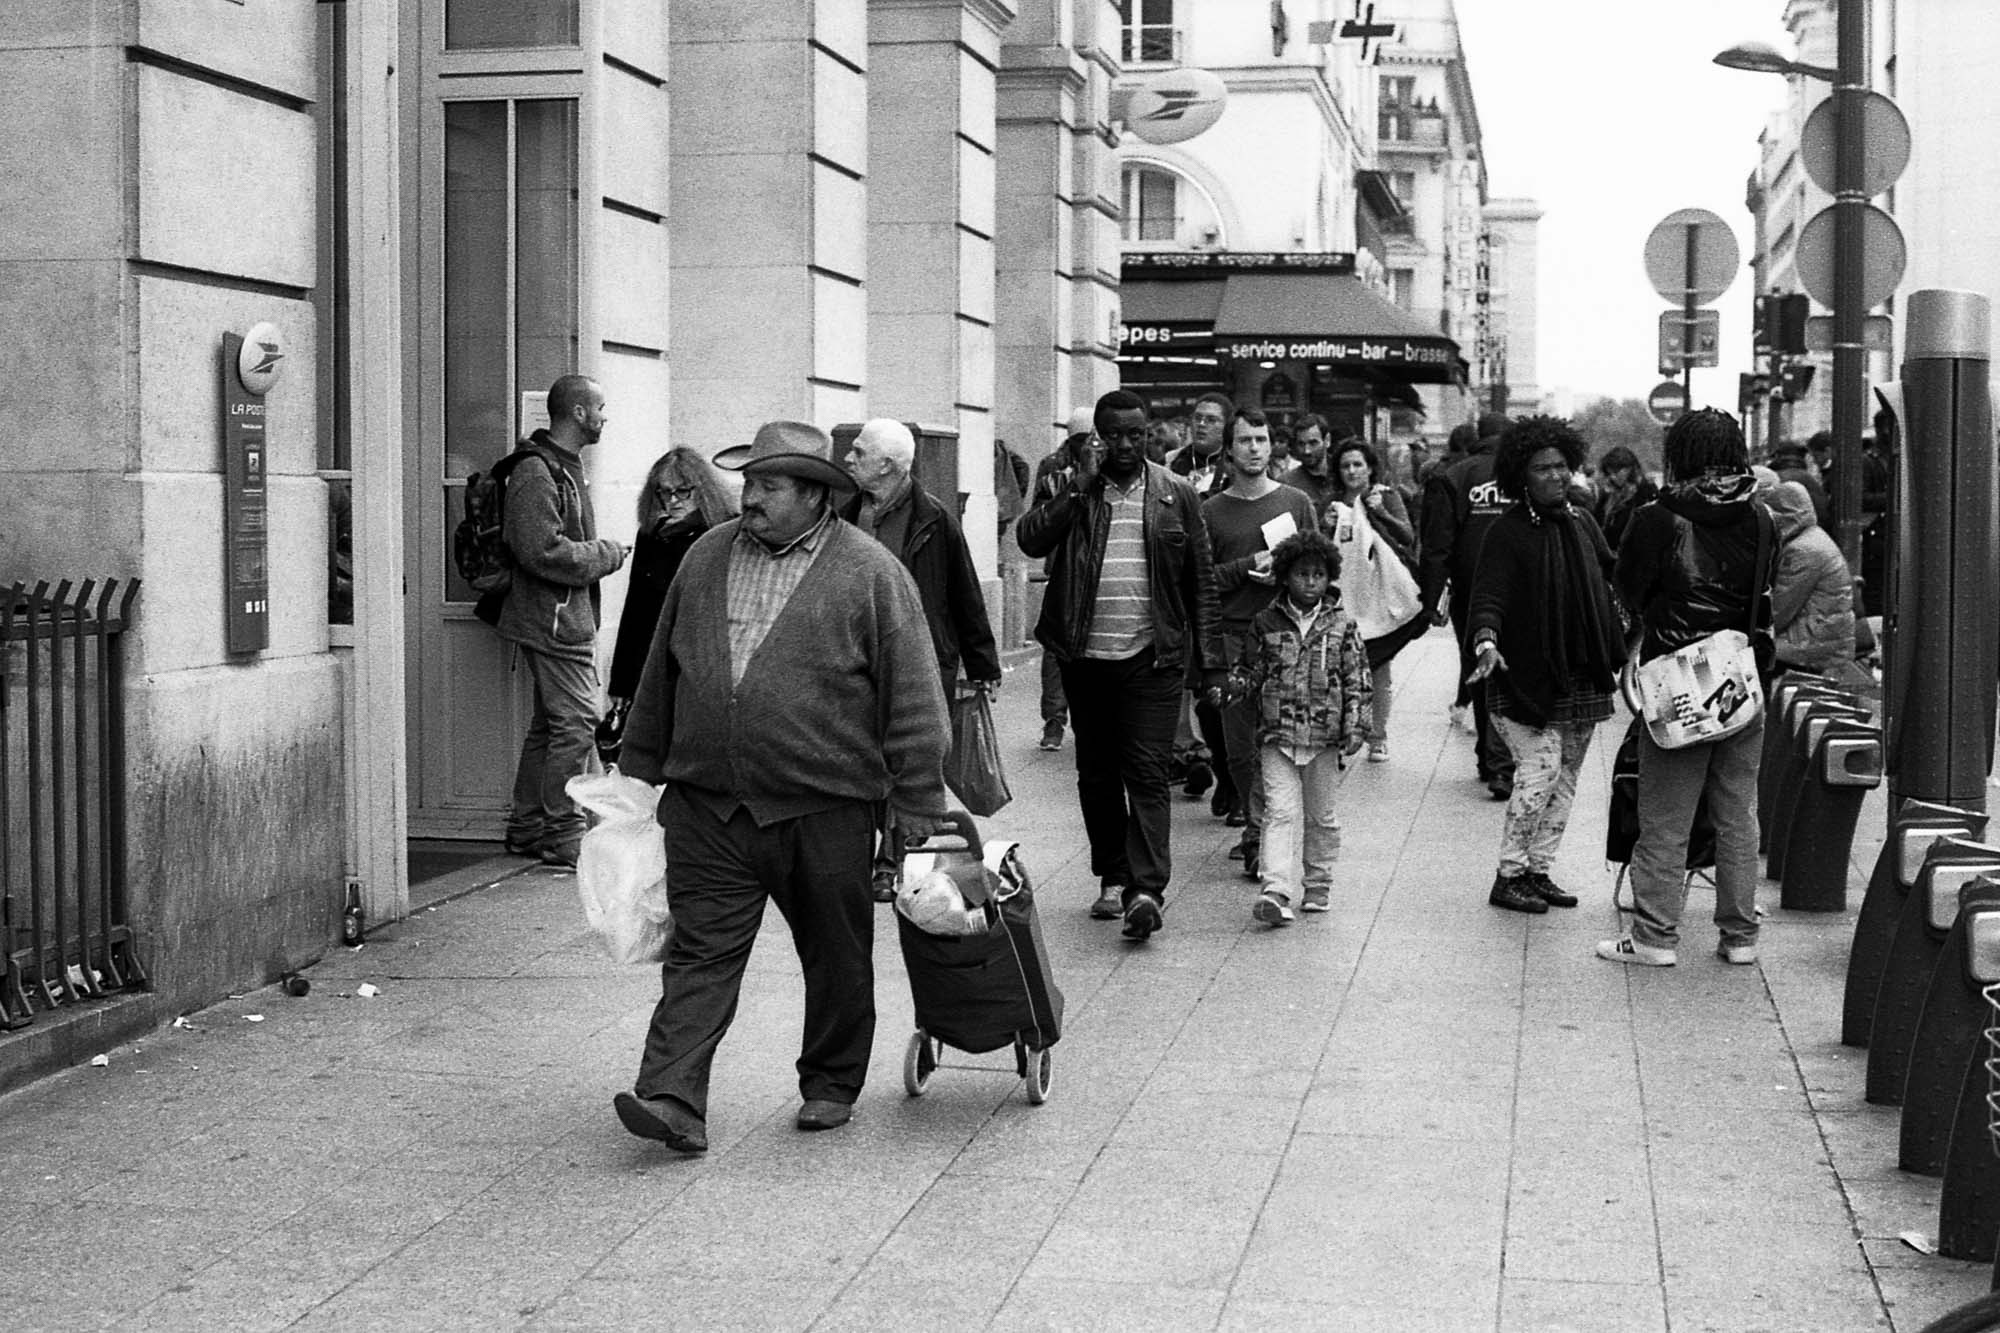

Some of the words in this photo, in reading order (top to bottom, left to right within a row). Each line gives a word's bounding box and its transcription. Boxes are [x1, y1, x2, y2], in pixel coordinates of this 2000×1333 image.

[1231, 340, 1286, 359] service
[1289, 340, 1346, 359] continu
[1361, 341, 1388, 360] bar
[231, 403, 245, 415] LA
